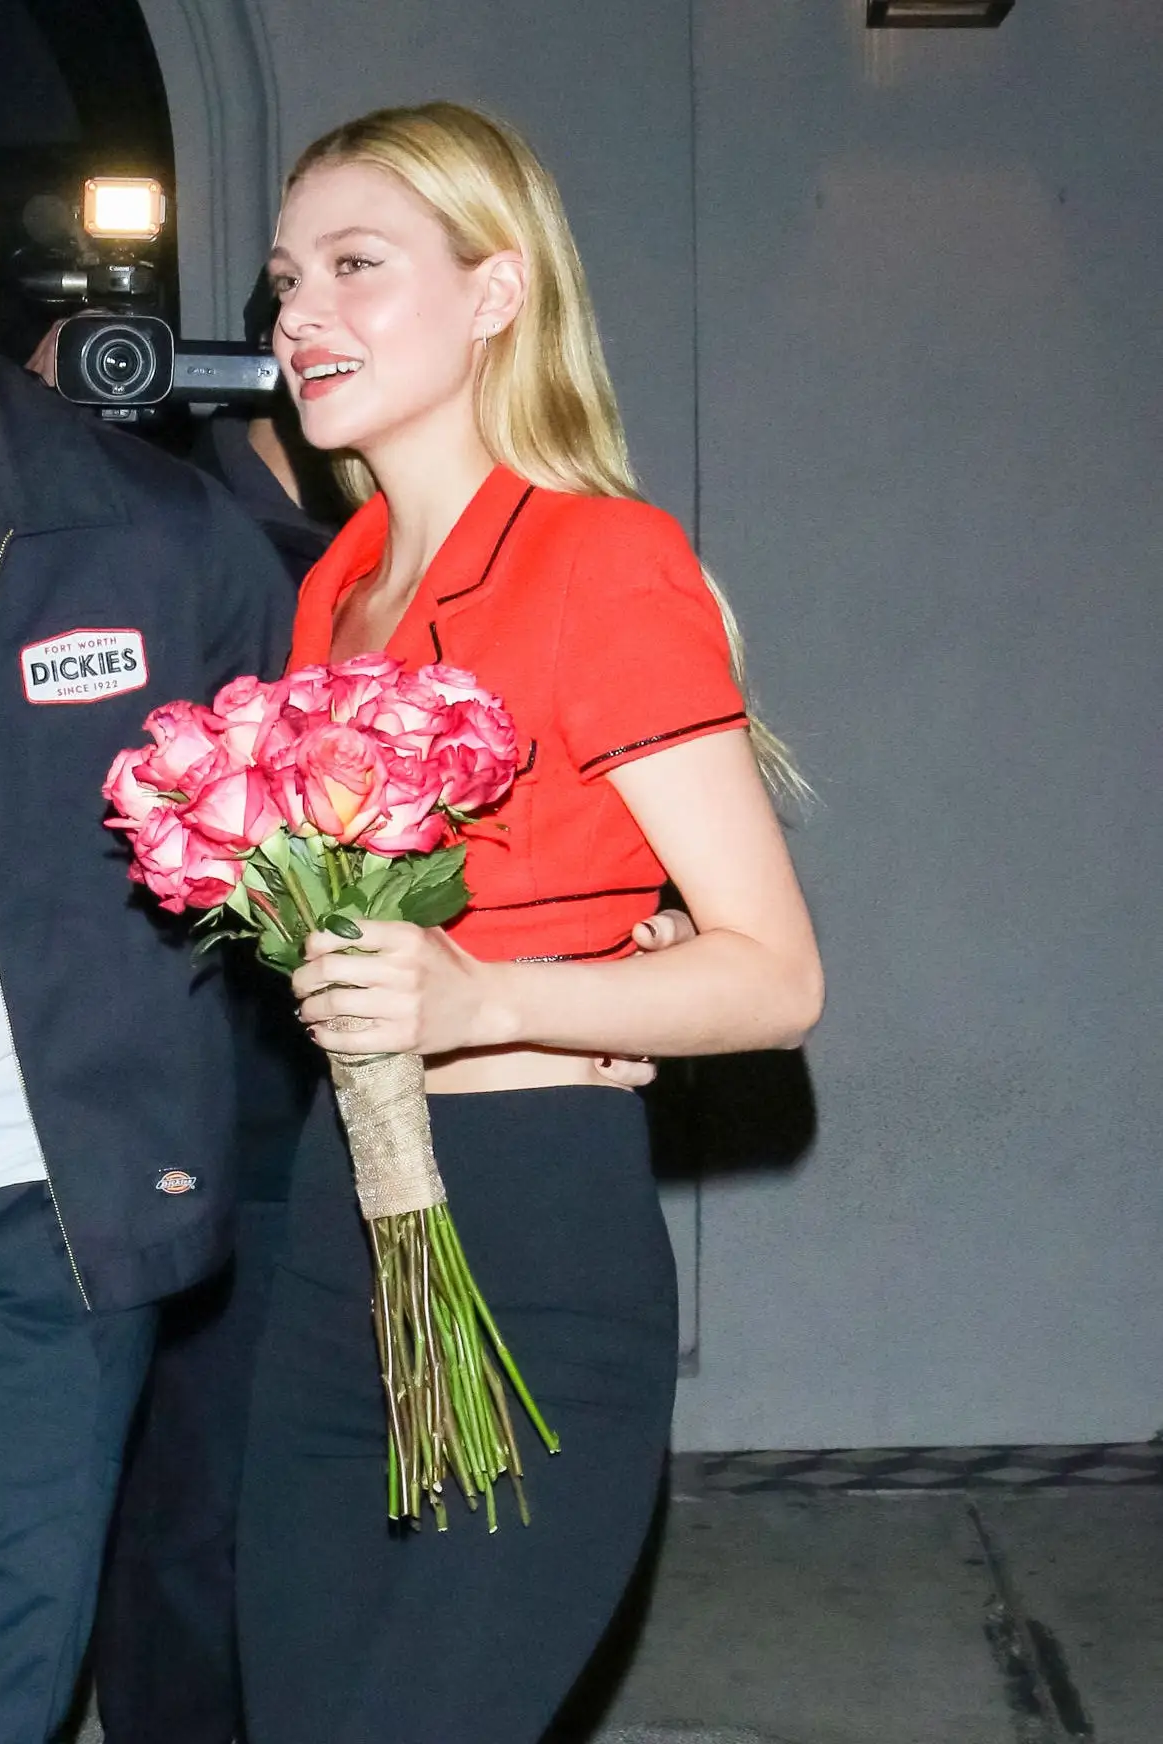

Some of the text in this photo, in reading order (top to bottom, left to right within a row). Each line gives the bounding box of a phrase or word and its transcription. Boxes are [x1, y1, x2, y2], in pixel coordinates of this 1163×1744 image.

[44, 636, 118, 655] FORT WORTH
[30, 647, 138, 686] DICKIES
[57, 679, 119, 697] SINCE 1922
